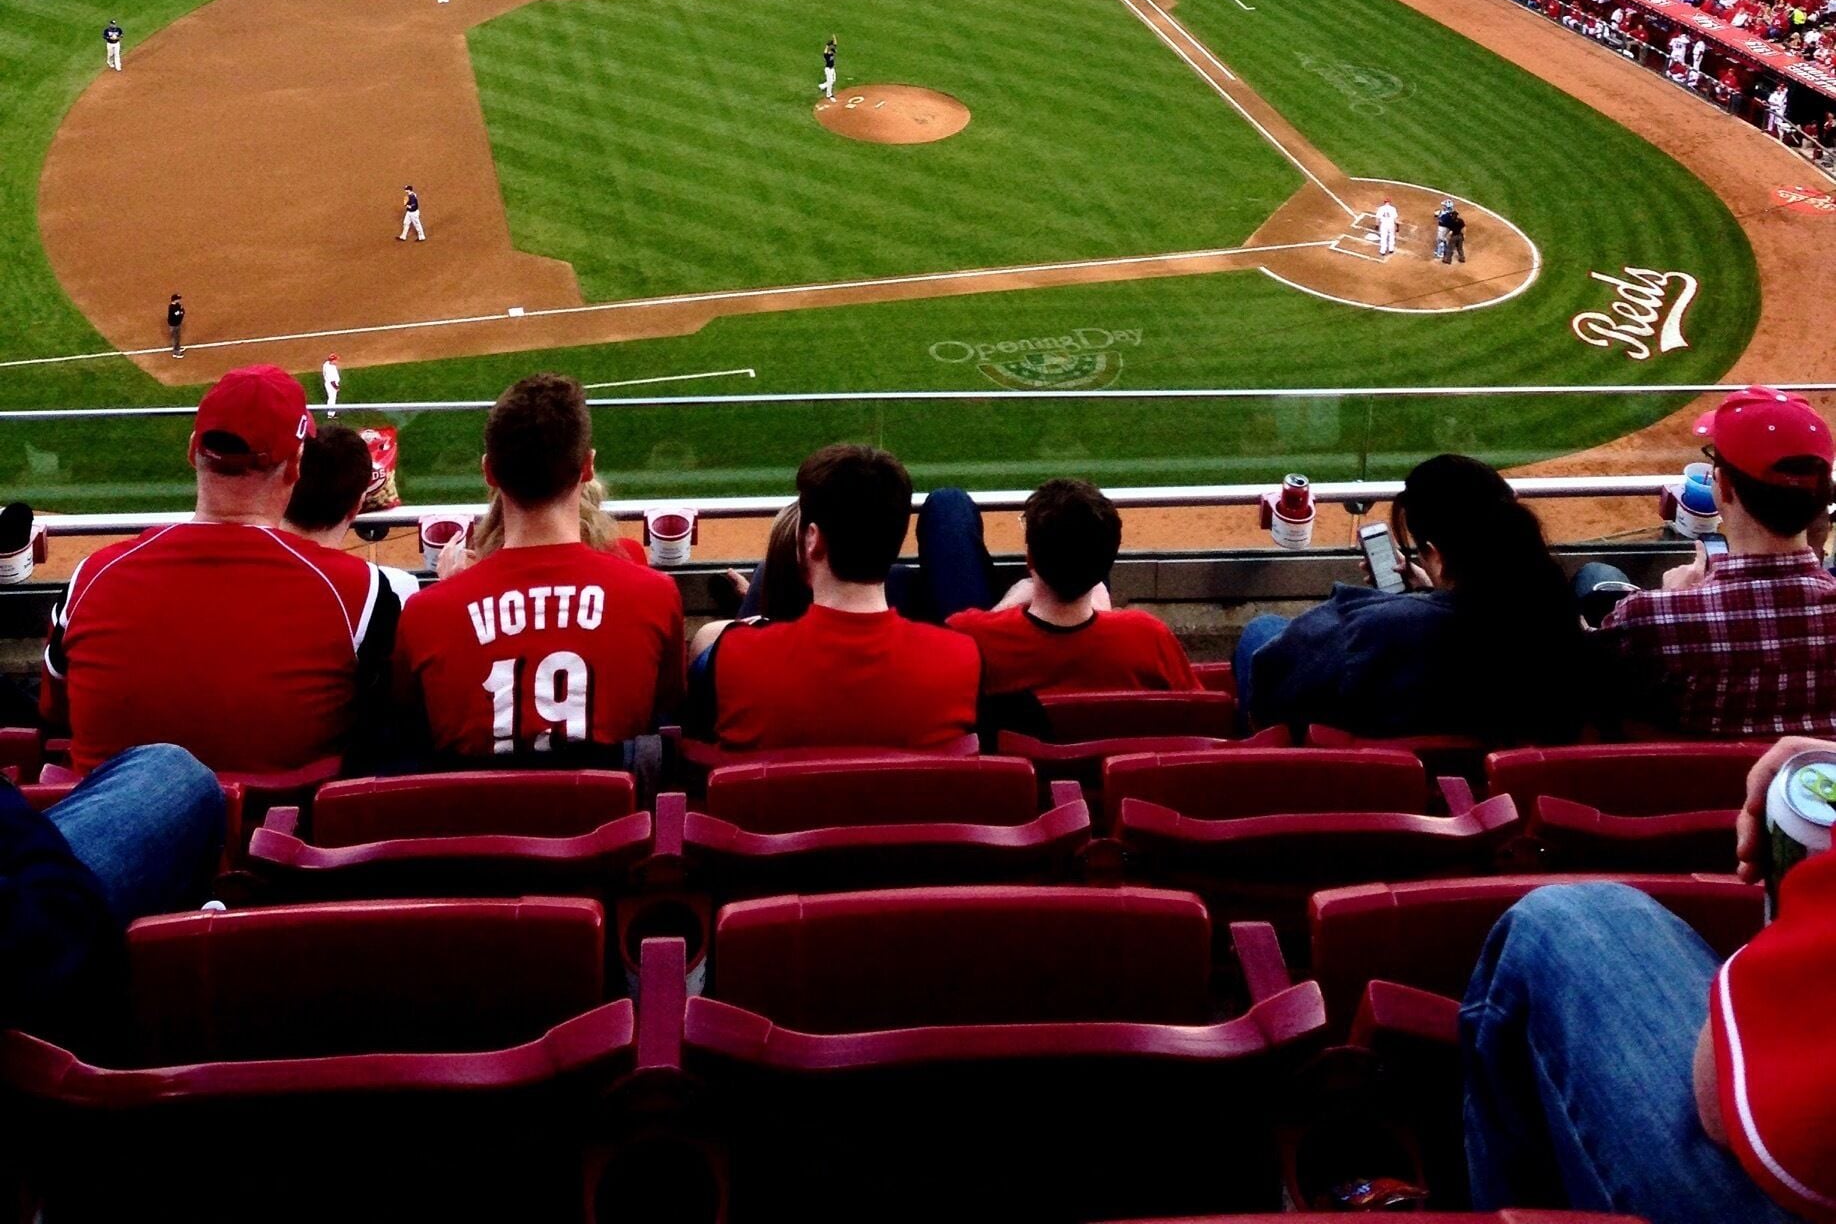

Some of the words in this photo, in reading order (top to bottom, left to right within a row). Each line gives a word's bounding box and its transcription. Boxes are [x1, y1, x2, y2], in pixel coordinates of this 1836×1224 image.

[929, 334, 1082, 364] Opening
[1072, 327, 1144, 349] Day
[1572, 266, 1698, 360] Reds
[467, 585, 605, 646] VOTTO
[482, 650, 588, 754] 19
